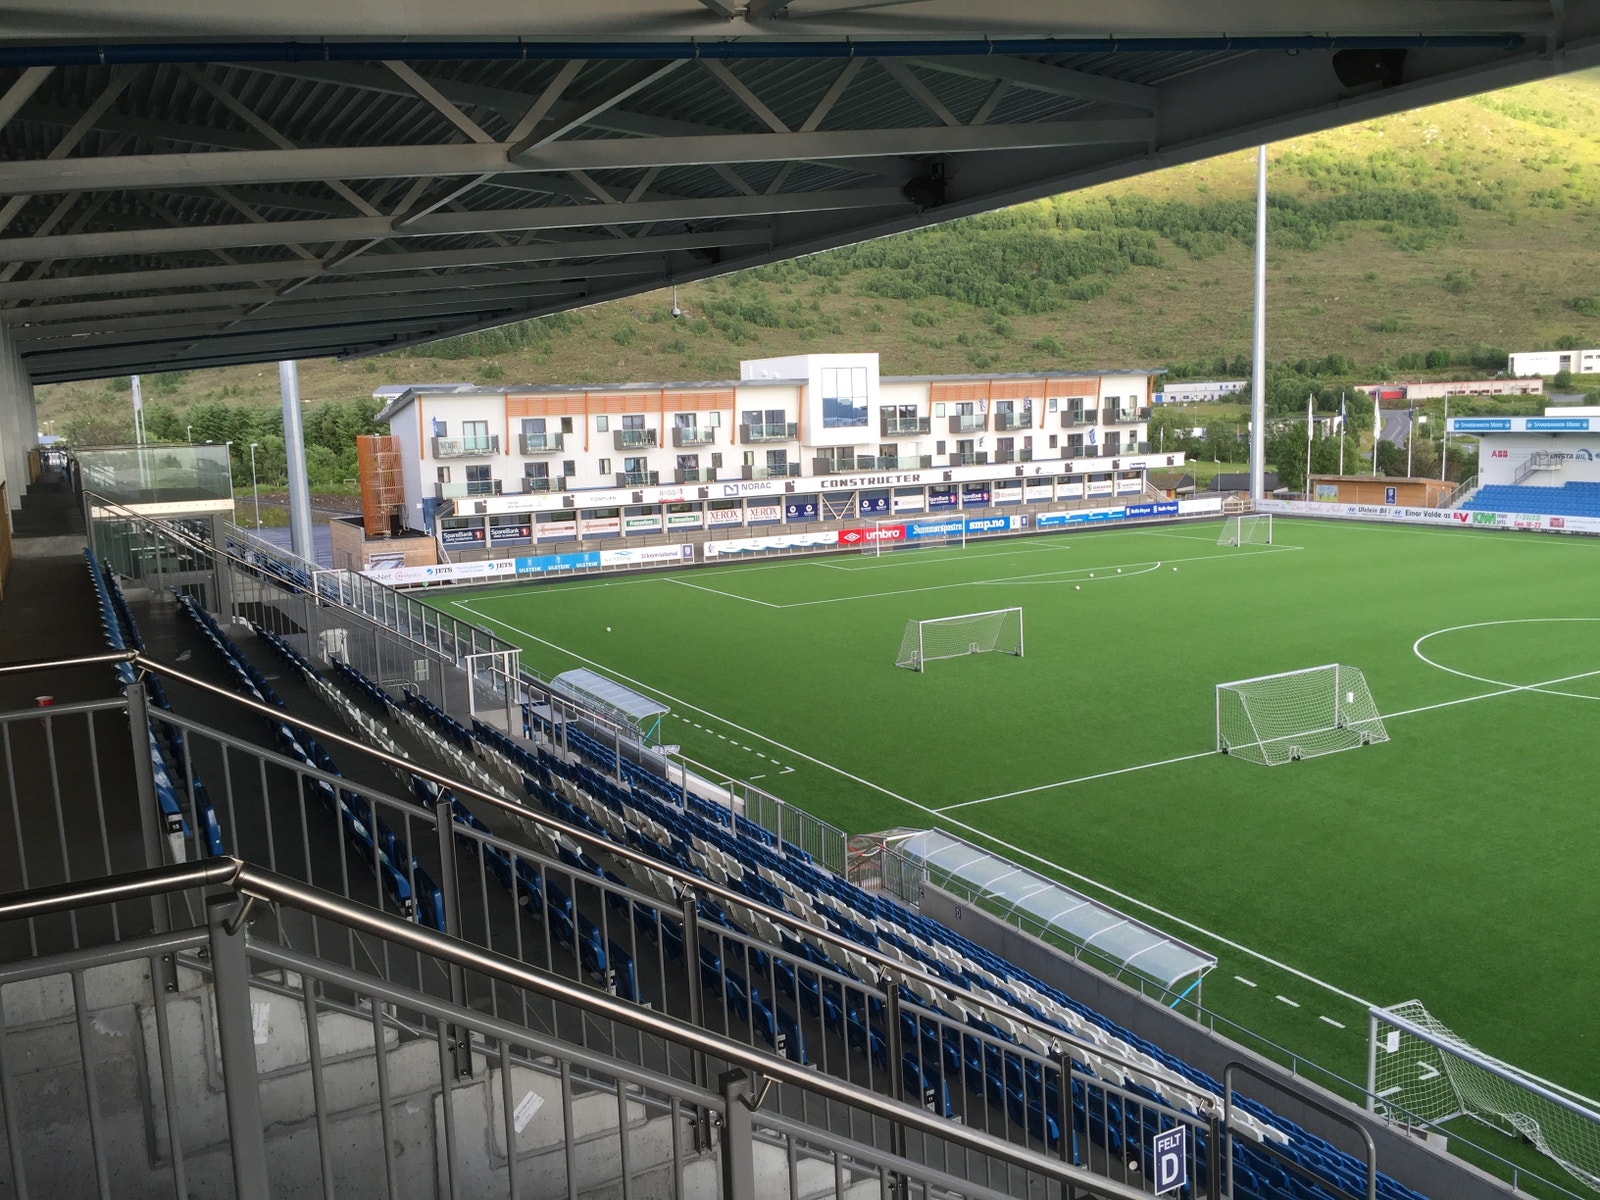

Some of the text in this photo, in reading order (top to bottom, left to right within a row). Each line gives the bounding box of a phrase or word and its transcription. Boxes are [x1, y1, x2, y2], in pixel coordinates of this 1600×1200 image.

[741, 482, 772, 490] NORAC
[820, 474, 921, 488] CONSTRUCTER
[710, 510, 737, 520] XEROX
[751, 507, 777, 516] XEROX
[1473, 512, 1496, 524] KIWI
[969, 519, 1004, 531] smp.no
[444, 530, 473, 538] SpareBank
[866, 529, 899, 539] umbro
[1158, 1133, 1181, 1152] FELT
[1162, 1152, 1179, 1185] D
